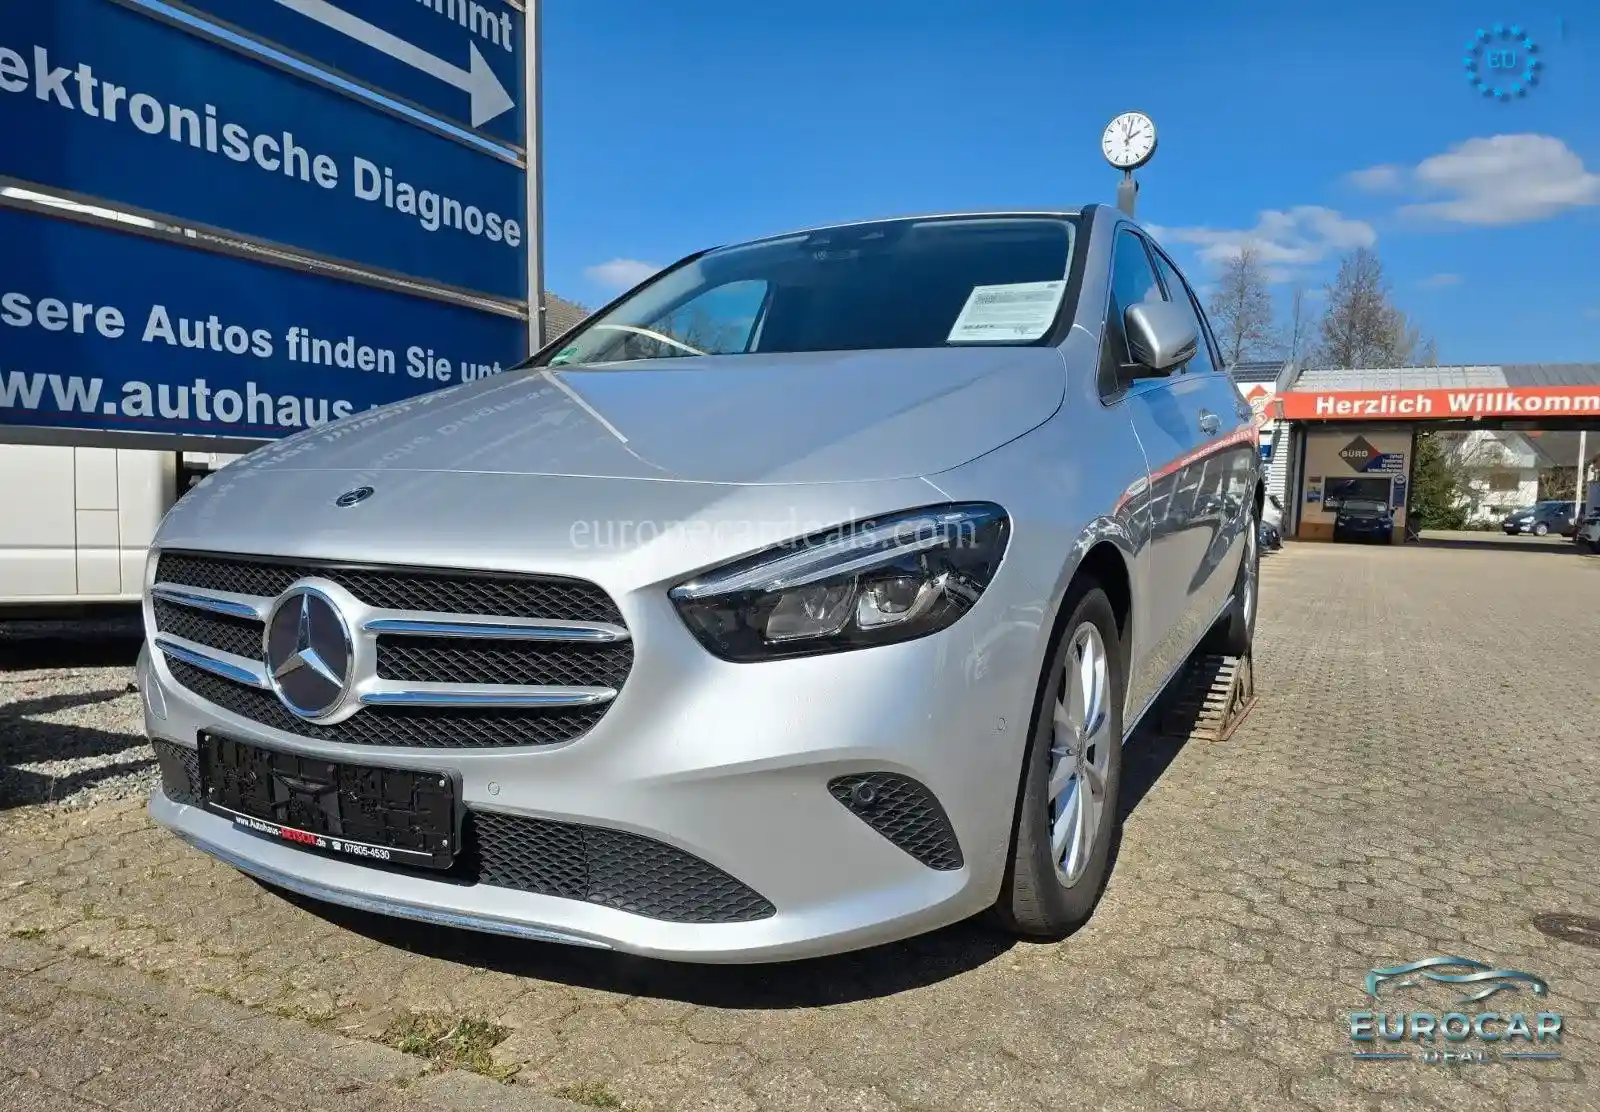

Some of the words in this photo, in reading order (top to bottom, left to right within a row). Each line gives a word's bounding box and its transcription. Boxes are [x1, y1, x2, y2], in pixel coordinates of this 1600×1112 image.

[354, 157, 521, 247] Diagnose
[0, 292, 125, 338] sere
[142, 304, 273, 358] Autos
[286, 327, 396, 374] finden
[406, 346, 452, 382] Sie
[1316, 393, 1432, 415] Herzlich
[1448, 392, 1600, 413] Willkomm
[344, 842, 390, 860] 07805-4530
